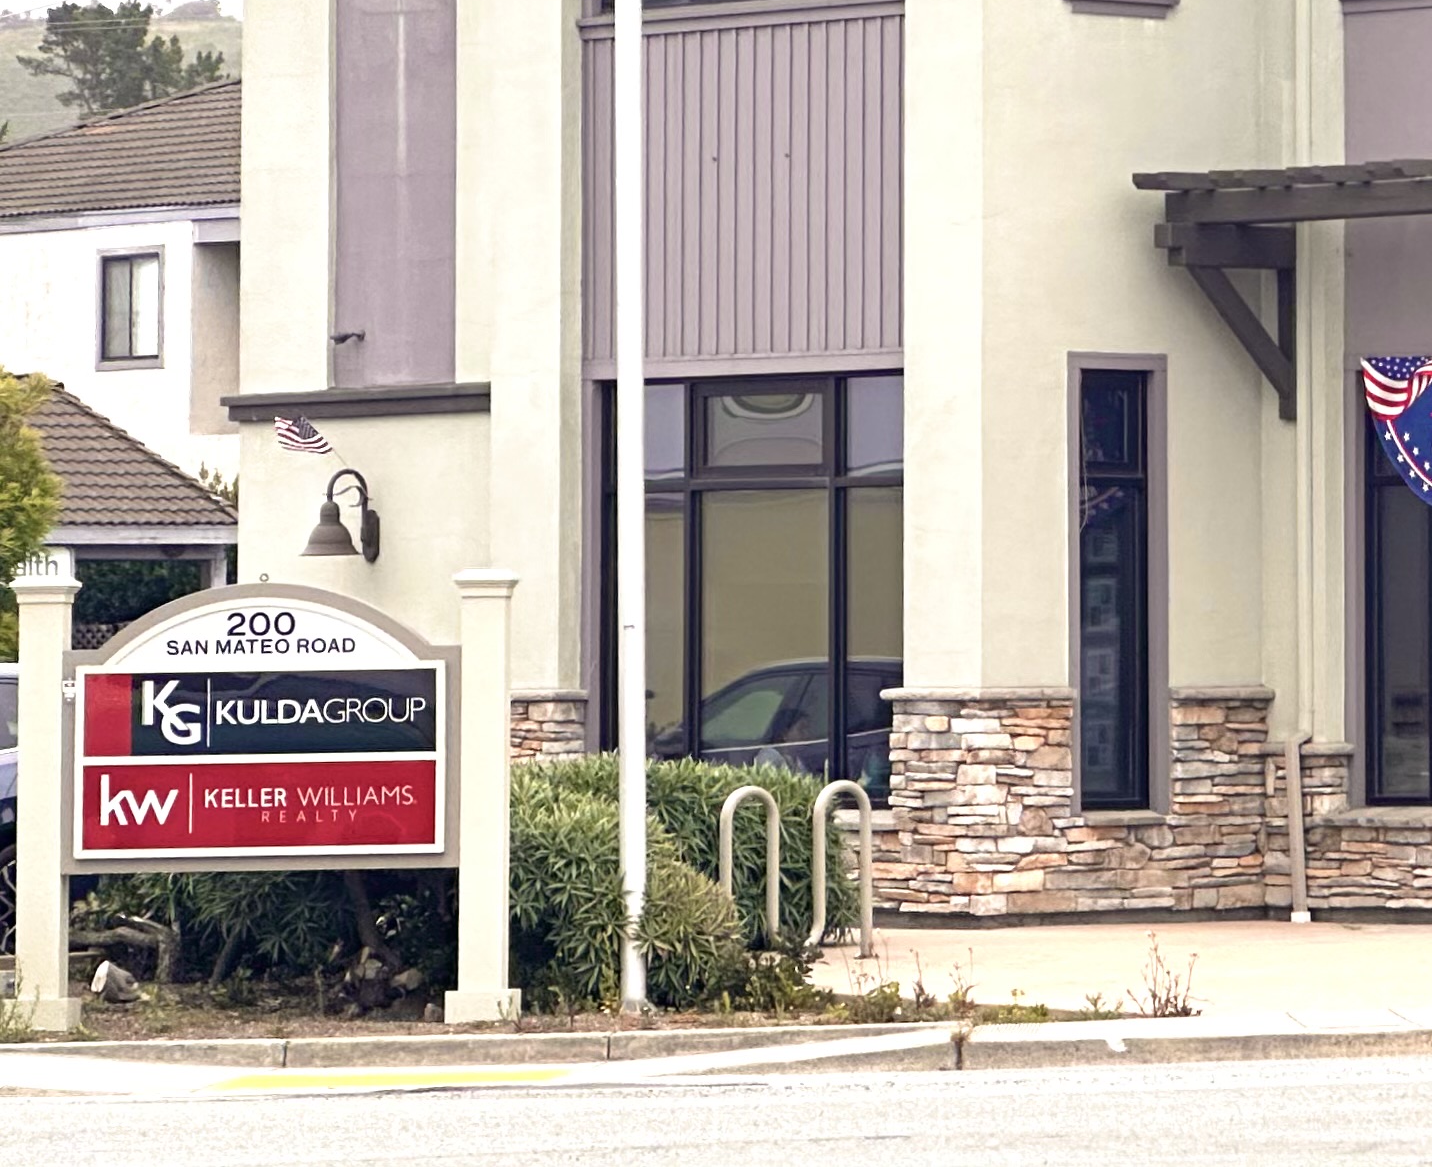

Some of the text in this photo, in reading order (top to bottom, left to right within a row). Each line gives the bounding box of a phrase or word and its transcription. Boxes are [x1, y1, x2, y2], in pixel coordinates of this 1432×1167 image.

[12, 551, 58, 576] alth
[226, 611, 296, 637] 200
[166, 637, 357, 656] SAN MATEO ROAD
[215, 697, 426, 726] KULDAGROUP
[100, 774, 179, 826] kw
[204, 784, 415, 810] KELLER WILLIAMS
[260, 809, 358, 823] REALTY
